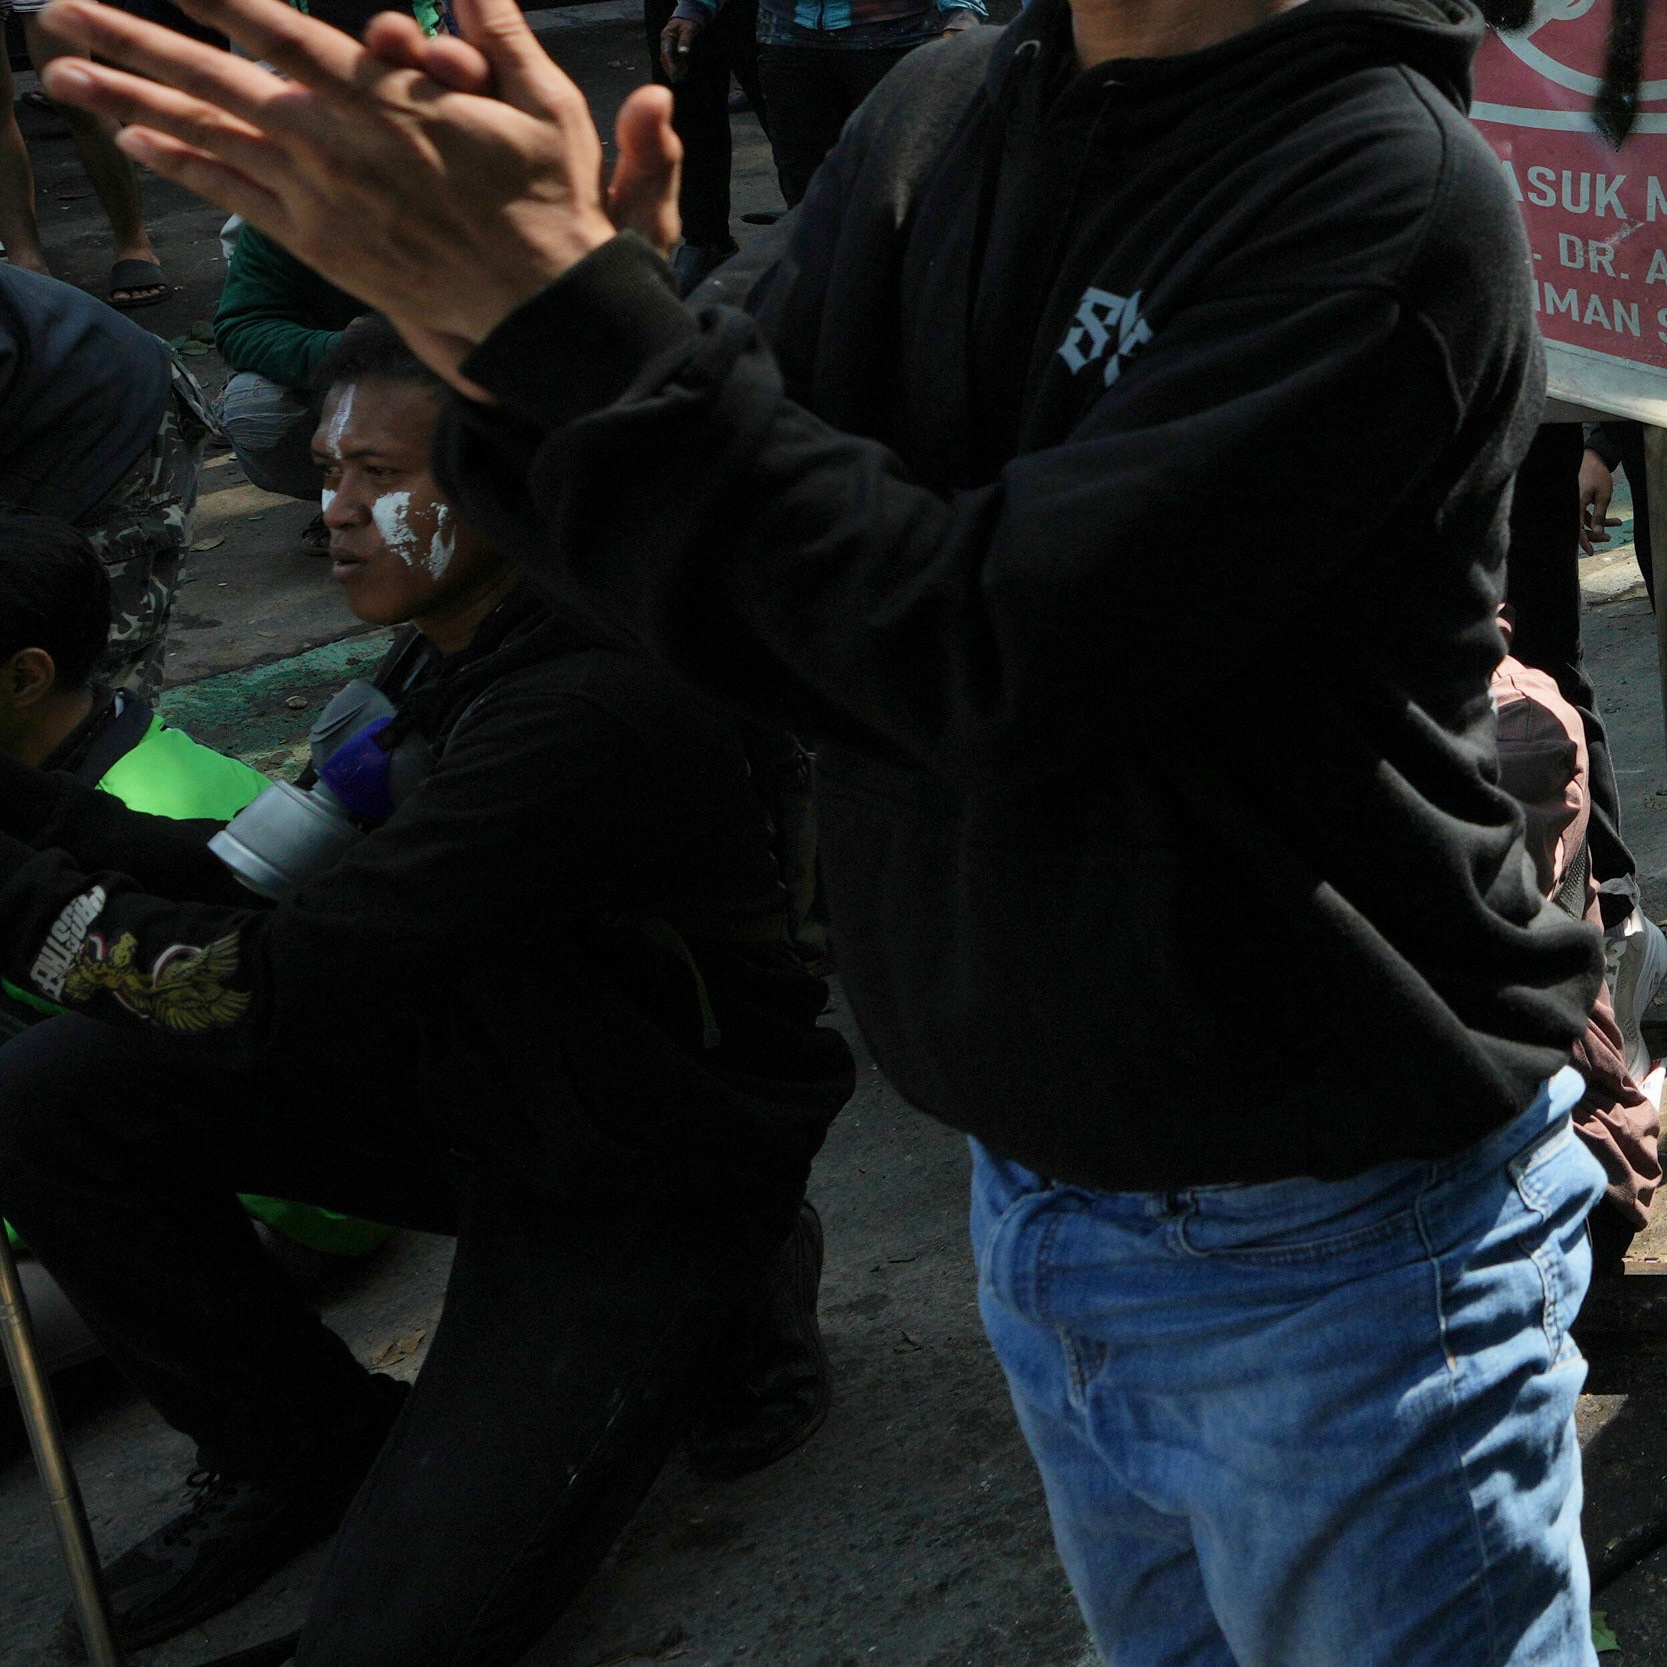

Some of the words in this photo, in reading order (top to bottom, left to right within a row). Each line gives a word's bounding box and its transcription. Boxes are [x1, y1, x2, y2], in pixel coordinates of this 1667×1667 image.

[1500, 159, 1628, 221] ASUK
[1558, 232, 1630, 280] DR.
[1533, 279, 1641, 338] MAN
